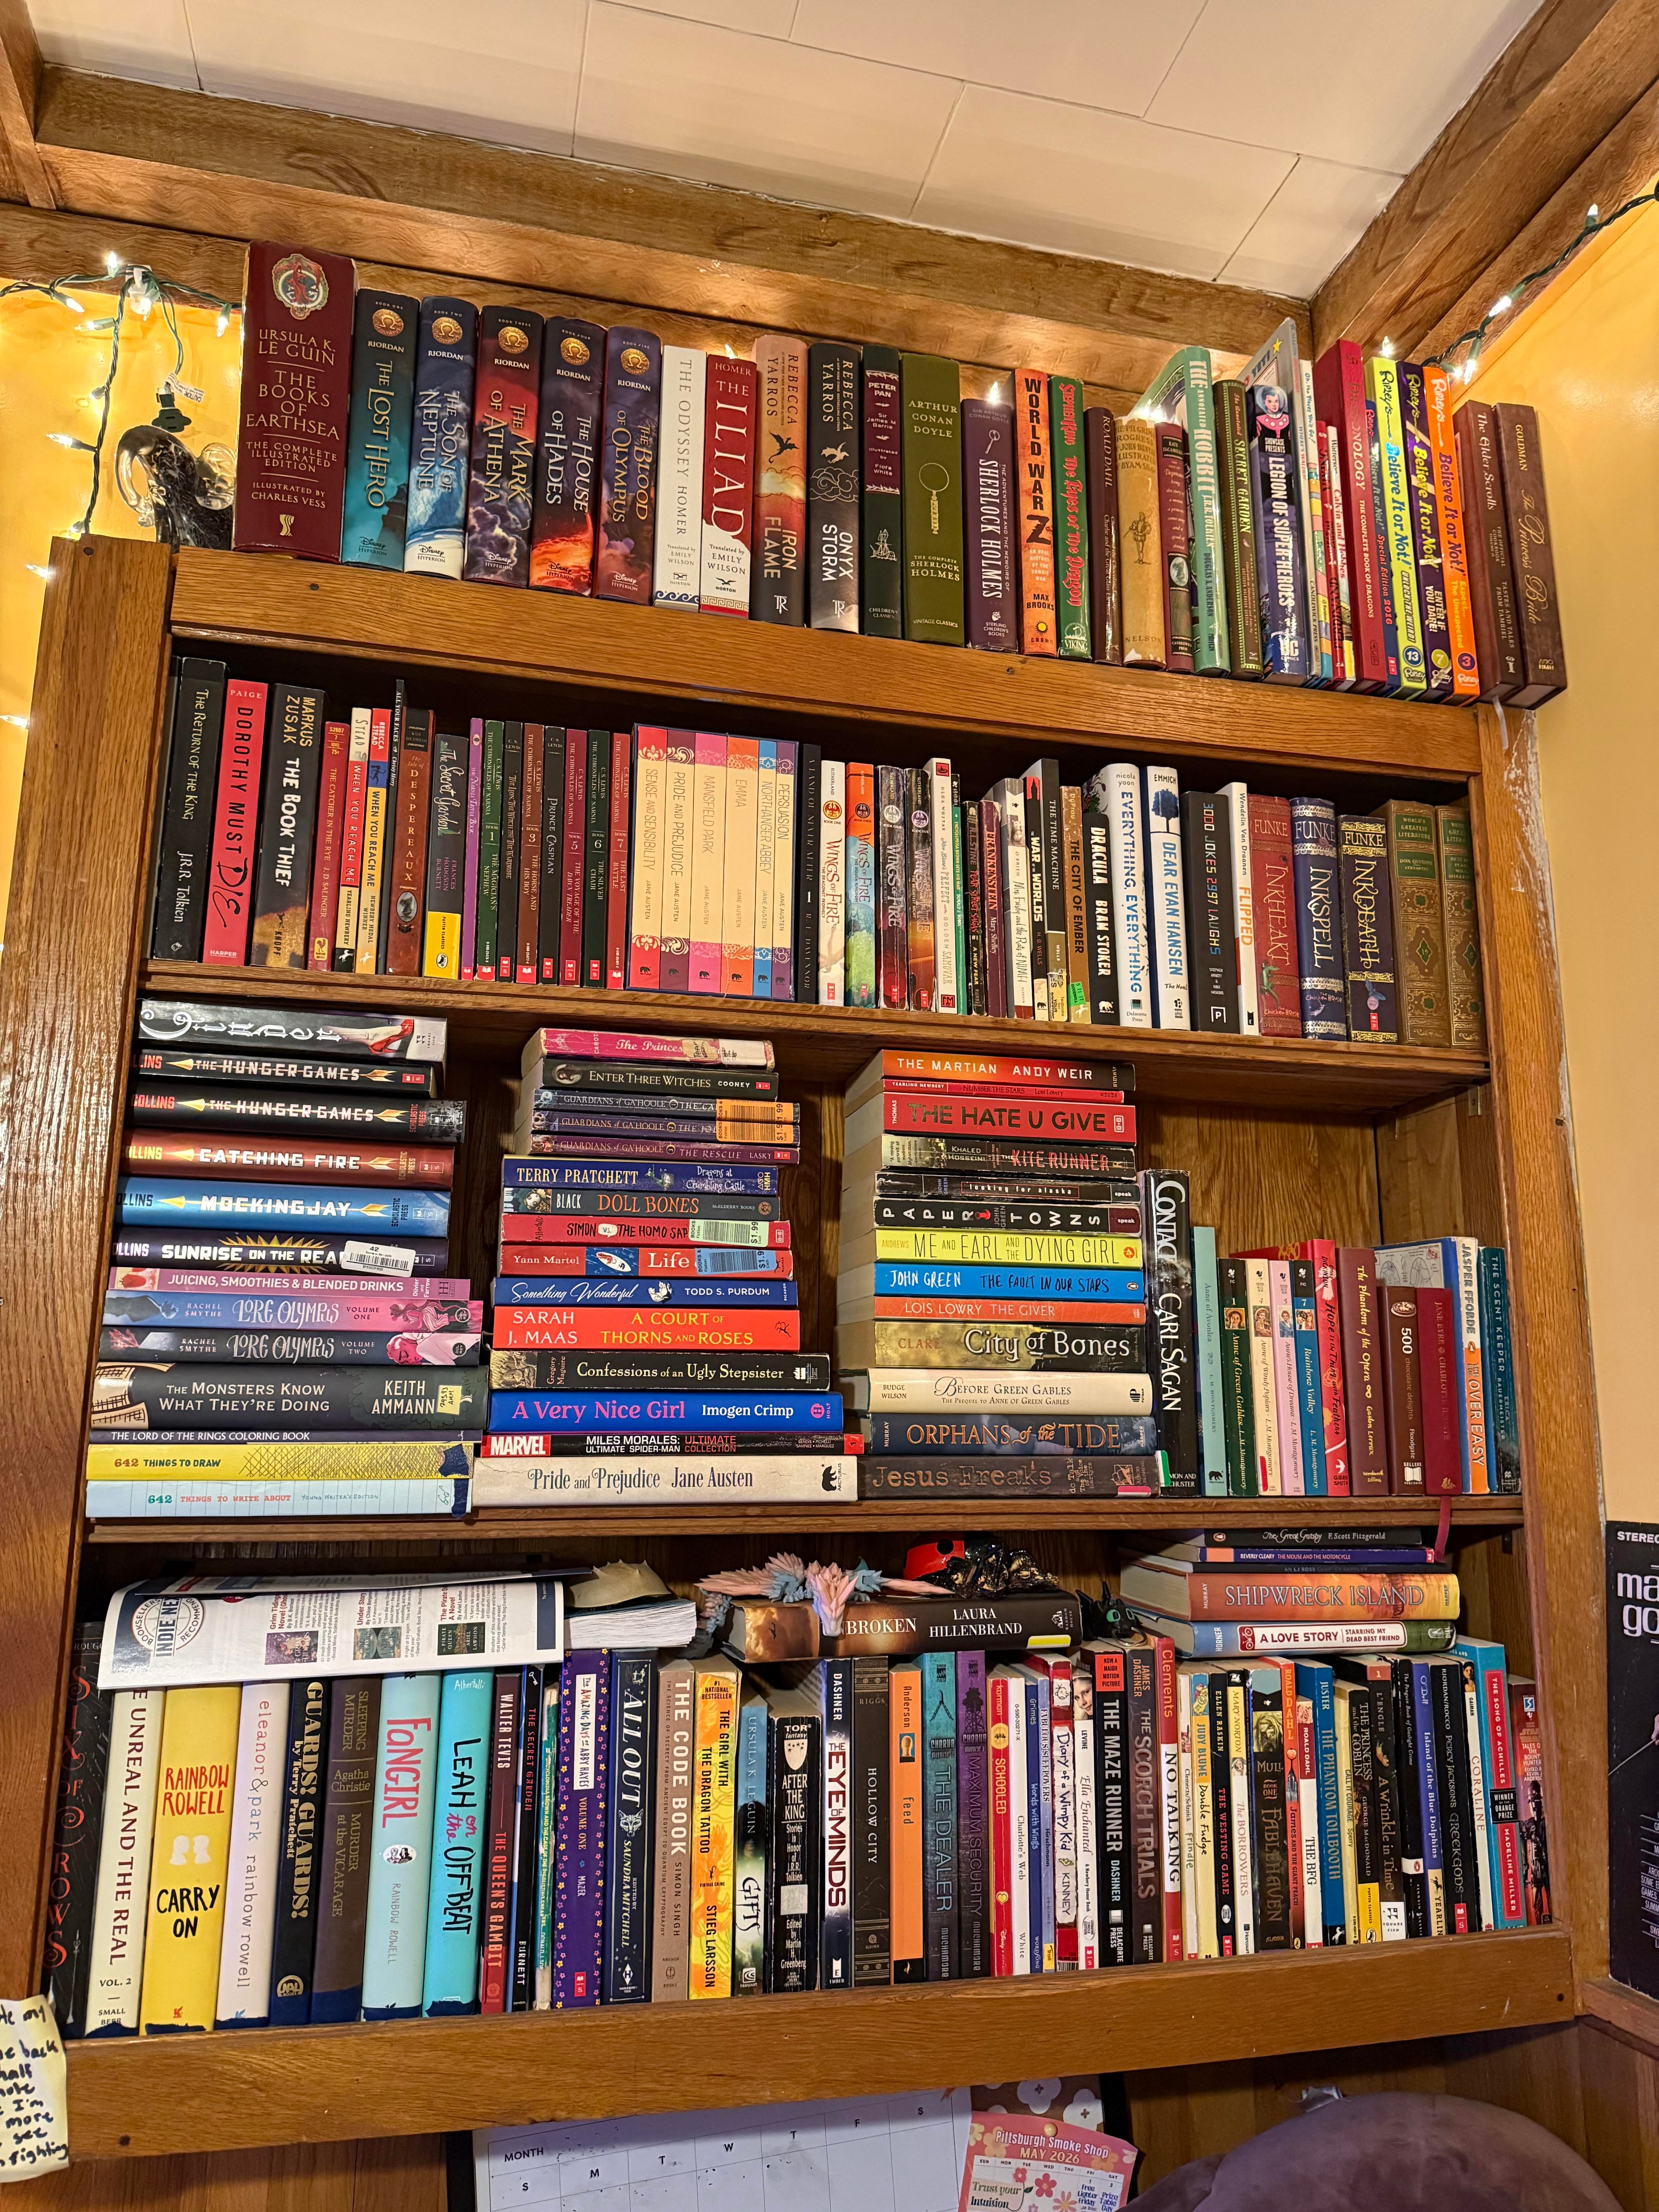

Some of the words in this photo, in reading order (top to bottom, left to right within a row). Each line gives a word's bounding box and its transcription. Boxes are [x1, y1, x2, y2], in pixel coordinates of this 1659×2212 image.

[259, 329, 318, 346] URSULA
[324, 339, 335, 352] K.
[368, 341, 404, 352] RIORDAN
[258, 341, 278, 354] LE
[286, 343, 335, 365] GUIN
[275, 370, 316, 390] THE
[680, 359, 692, 393] THE
[715, 362, 751, 376] HOMER
[259, 385, 330, 407] BOOKS
[716, 380, 749, 397] THE
[281, 401, 307, 416] OF
[910, 400, 958, 413] ARTHUR
[1024, 378, 1041, 456] WORLD
[246, 414, 339, 440] EARTHSEA
[912, 412, 953, 425] CONAN
[676, 400, 691, 478] ODYSSEY
[914, 426, 952, 438] DOYLE
[246, 441, 268, 450] THE
[274, 443, 337, 461] COMPLETE
[252, 450, 330, 467] ILLUSTRATED
[1515, 424, 1527, 471] GOLDMAN
[265, 459, 316, 472] EDITION
[712, 401, 748, 536] ILIAD
[253, 482, 312, 494] ILLUSTRATED
[979, 459, 1001, 534] SHERLOCK
[1028, 463, 1045, 511] WAR
[252, 492, 298, 503] CHARLES
[302, 497, 325, 508] VESS
[676, 485, 687, 536] HOMER
[1026, 514, 1051, 545] Z
[712, 553, 742, 563] EMILY
[764, 517, 781, 579] FLAME
[782, 529, 797, 570] IRON
[708, 563, 746, 575] WILSON
[981, 539, 1002, 599] HOLMES
[1027, 602, 1054, 611] BROOKS
[230, 689, 262, 699] PAIGE
[284, 695, 301, 743] ZUSAK
[299, 696, 316, 748] MARKUS
[230, 707, 253, 792] DOROTHY
[283, 758, 299, 789] THE
[1154, 774, 1176, 784] EMMICH
[673, 772, 685, 801] PRIDE
[735, 779, 747, 808] EMMA
[280, 794, 297, 838] BOOK
[675, 804, 683, 819] AND
[226, 803, 246, 854] MUST
[671, 823, 684, 878] PREJUDICE
[1090, 827, 1108, 884] DRACULA
[177, 851, 191, 882] J.R.R.
[275, 843, 295, 887] THIEF
[174, 885, 190, 922] Tolkien
[1096, 900, 1108, 932] BRAM
[1239, 886, 1253, 946] FLIPPED
[273, 931, 282, 956] KNOPF
[1097, 935, 1111, 976] STOKER
[897, 1058, 924, 1069] THE
[932, 1060, 996, 1074] MARTIAN
[1012, 1066, 1051, 1077] ANDY
[1058, 1068, 1092, 1080] WEIR
[907, 1103, 952, 1125] THE
[961, 1107, 1021, 1128] HATE
[1029, 1111, 1042, 1128] U
[1052, 1111, 1106, 1132] GIVE
[199, 1148, 304, 1167] CATCHING
[314, 1154, 360, 1170] FIRE
[517, 1168, 559, 1183] TERRY
[565, 1169, 638, 1185] PRATCHETT
[200, 1195, 350, 1217] MOCKINGJAY
[556, 1194, 581, 1209] BLACK
[598, 1194, 640, 1212] DOLL
[645, 1198, 699, 1213] BONES
[514, 1255, 539, 1264] Yann
[543, 1255, 579, 1264] Martel
[647, 1253, 690, 1267] Life
[168, 1274, 219, 1288] JUICING,
[221, 1277, 289, 1288] SMOOTHIES
[292, 1279, 301, 1288] &
[303, 1280, 358, 1290] BLENDED
[359, 1281, 404, 1292] DRINKS
[511, 1283, 566, 1302] Something
[570, 1282, 639, 1299] Wonderful
[513, 1312, 574, 1324] SARAH
[631, 1312, 642, 1324] A
[651, 1312, 709, 1325] COURT
[905, 1303, 933, 1314] LOIS
[938, 1304, 982, 1316] LOWRY
[991, 1305, 1015, 1316] THE
[1019, 1305, 1055, 1316] GIVER
[508, 1331, 517, 1346] J.
[525, 1332, 577, 1344] MAAS
[601, 1331, 672, 1344] THORNS
[698, 1333, 753, 1345] ROSES
[1401, 1327, 1413, 1354] 500
[384, 1381, 425, 1395] KEITH
[371, 1400, 435, 1414] AMMANN
[512, 1401, 529, 1419] A
[534, 1401, 586, 1423] Very
[594, 1400, 639, 1419] Nice
[647, 1401, 685, 1419] Girl
[702, 1405, 750, 1418] Imogen
[754, 1405, 793, 1418] Crimp
[1468, 1380, 1481, 1420] OVER
[491, 1436, 546, 1455] MARVEL
[1470, 1423, 1485, 1466] EASY
[114, 1459, 139, 1467] 642
[143, 1459, 177, 1467] THINGS
[179, 1459, 191, 1467] TO
[193, 1459, 221, 1467] DRAW
[528, 1468, 570, 1489] Pride
[574, 1477, 590, 1488] and
[592, 1468, 659, 1494] Prejudice
[672, 1467, 703, 1487] Jane
[708, 1467, 753, 1487] Austen
[1226, 1585, 1342, 1607] SHIPWRECK
[1350, 1585, 1424, 1606] ISLAND
[953, 1607, 997, 1620] LAURA
[929, 1623, 1022, 1637] HILLENBRAND
[674, 1680, 690, 1721] THE
[833, 1673, 843, 1721] DASHNER
[673, 1731, 689, 1787] CODE
[1164, 1751, 1178, 1783] NO
[165, 1764, 229, 1791] RAINBOW
[782, 1774, 808, 1790] AFTER
[162, 1791, 225, 1816] ROWELL
[787, 1790, 803, 1803] THE
[867, 1767, 878, 1826] HOLLOW
[1472, 1756, 1485, 1831] CORALINE
[785, 1804, 805, 1820] KING
[671, 1798, 687, 1856] BOOK
[1166, 1790, 1180, 1883] TALKING
[868, 1830, 878, 1863] CITY
[156, 1885, 220, 1915] CARRY
[173, 1916, 198, 1939] ON
[19, 2040, 58, 2058] back
[505, 2148, 544, 2162] MONTH
[996, 2131, 1046, 2147] Pittsburgh
[1049, 2137, 1080, 2152] Smoke
[1084, 2144, 1108, 2159] Shop
[1020, 2147, 1046, 2159] MAY
[1049, 2151, 1080, 2164] 2026
